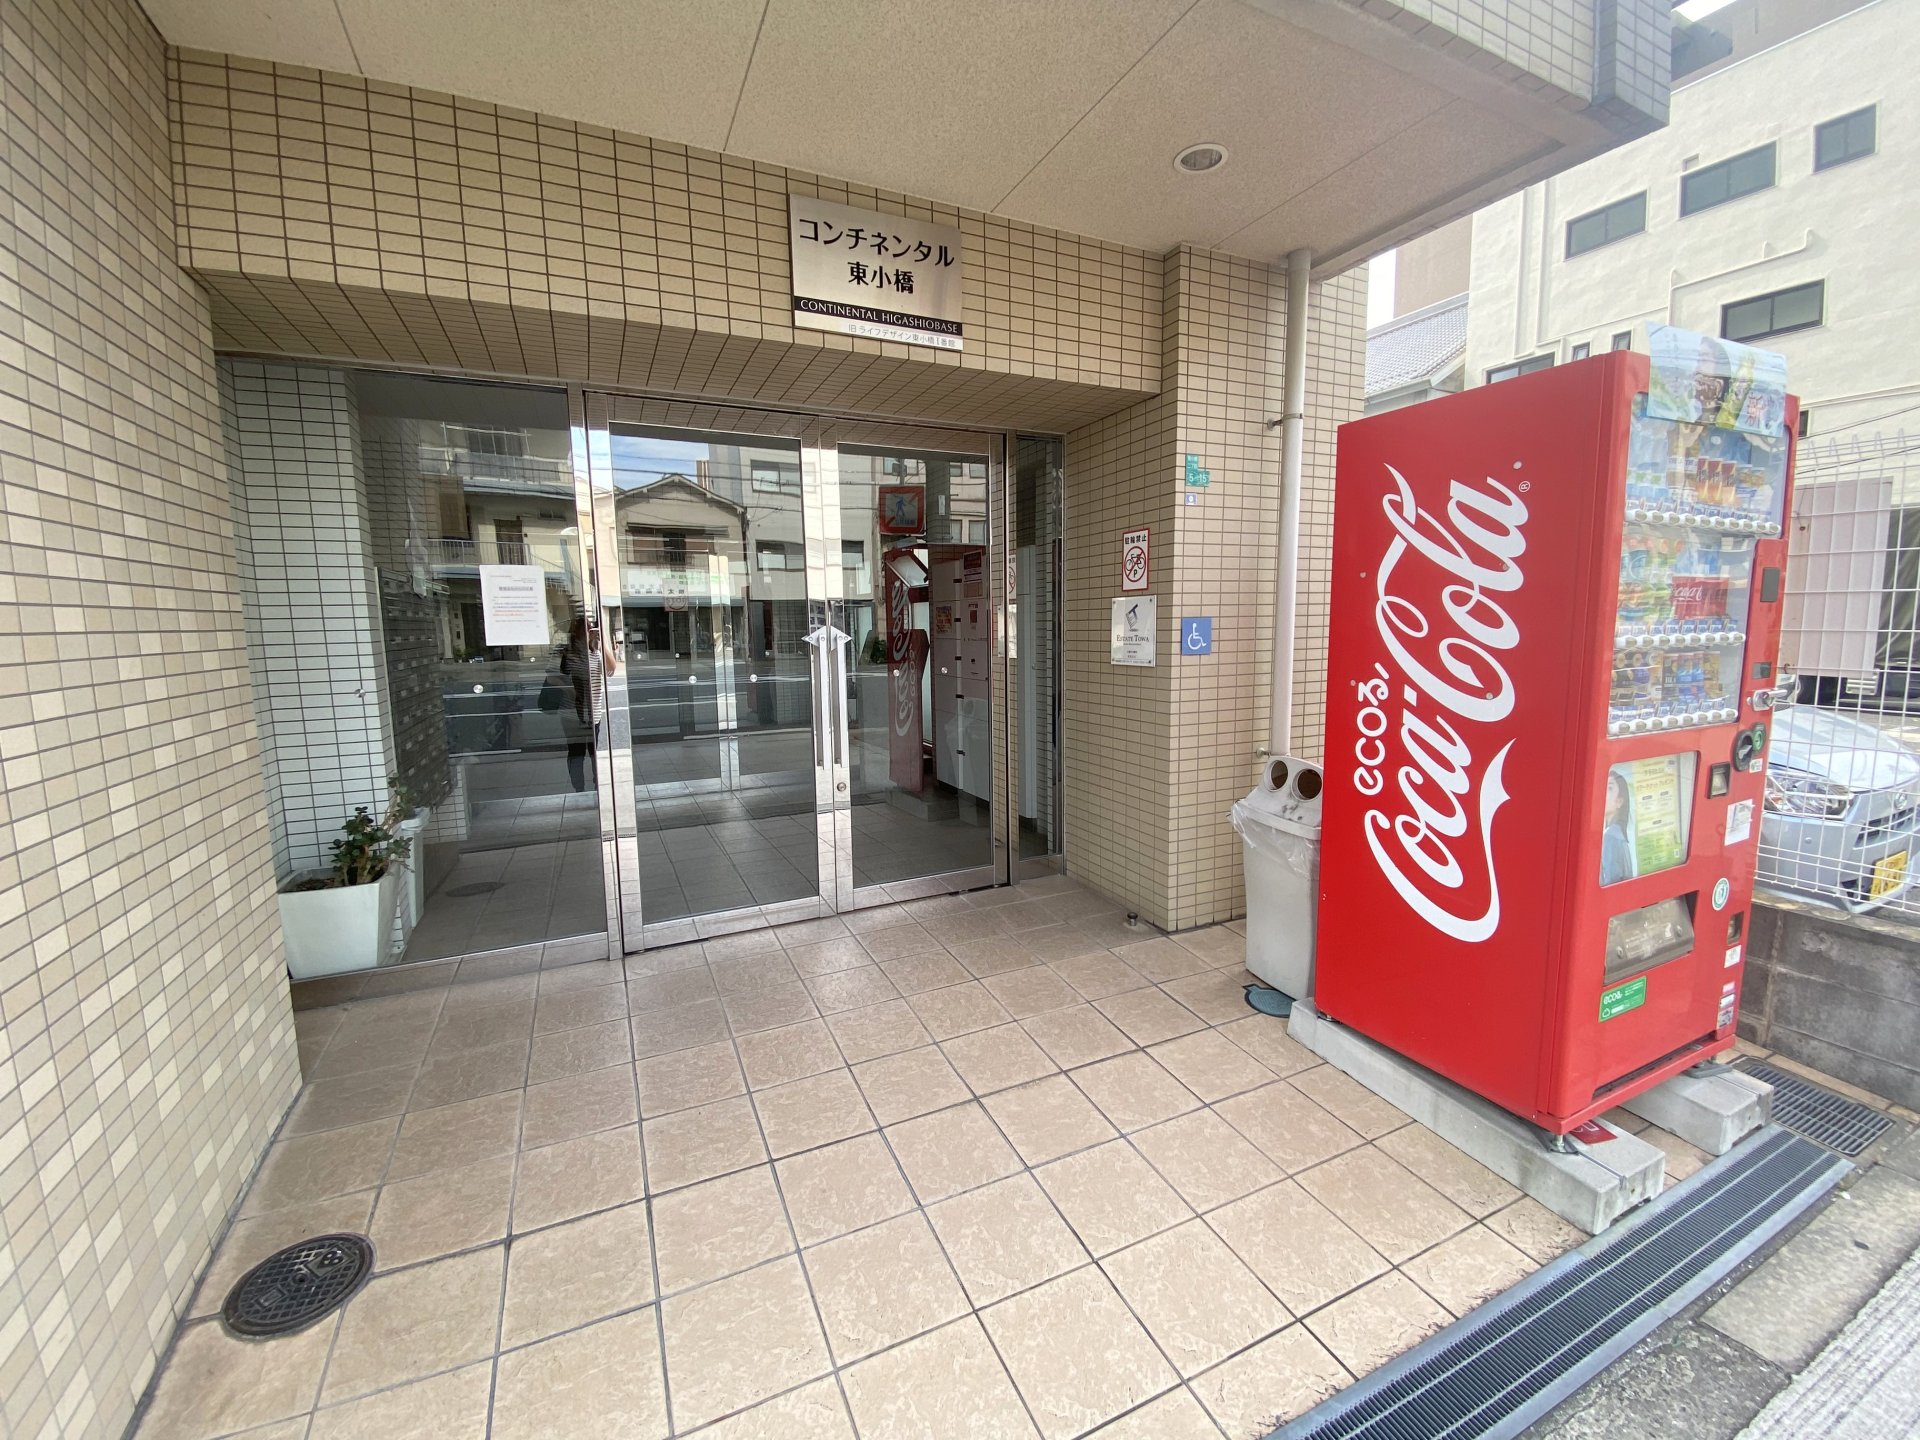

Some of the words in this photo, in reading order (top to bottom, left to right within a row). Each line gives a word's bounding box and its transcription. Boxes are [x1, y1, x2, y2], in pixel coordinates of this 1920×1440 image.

[799, 217, 955, 267] コンチネンタル
[847, 260, 914, 294] 東小橋
[800, 299, 879, 322] CONTINENTAL
[881, 311, 958, 334] HIGASHIOBASE
[1364, 463, 1530, 943] Coca-Cola
